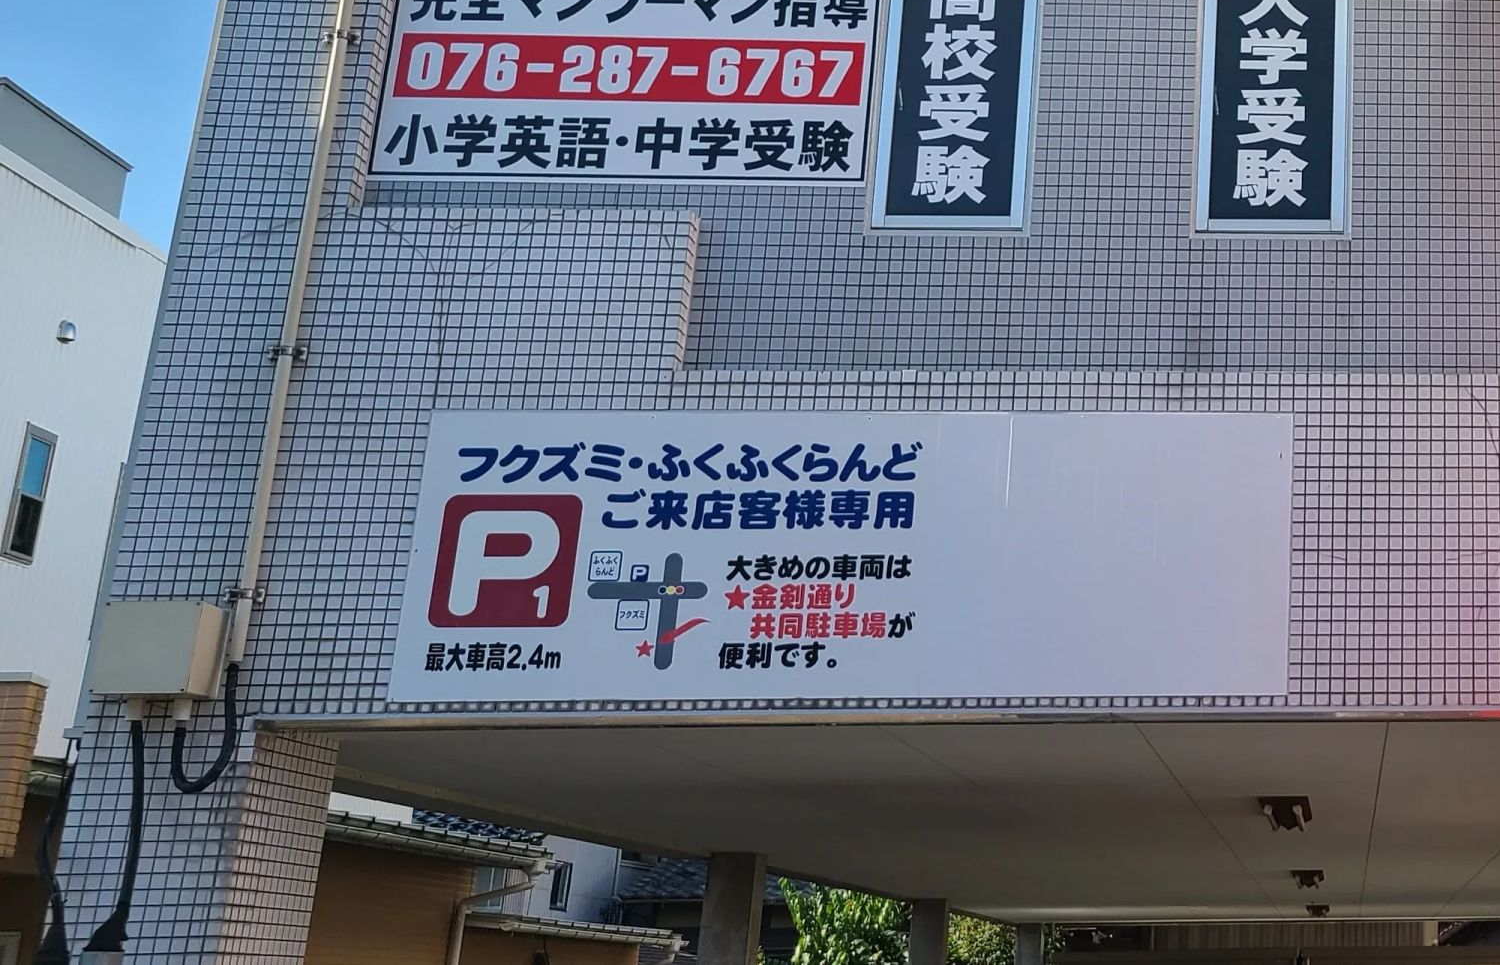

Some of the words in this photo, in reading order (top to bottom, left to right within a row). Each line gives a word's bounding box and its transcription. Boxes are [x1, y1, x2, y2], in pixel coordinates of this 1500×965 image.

[406, 39, 854, 99] 076-287-6767
[384, 114, 853, 173] 小学英語・中学受験
[458, 441, 923, 483] フクズミ・ふくふくらんど
[601, 489, 915, 530] ご来店客様専用
[726, 554, 912, 581] 大きめの車両は
[620, 610, 645, 619] フクズミ
[750, 611, 916, 639] 共同駐車場が
[425, 642, 562, 671] 最大車高2.4m
[718, 641, 838, 669] 便利です。
